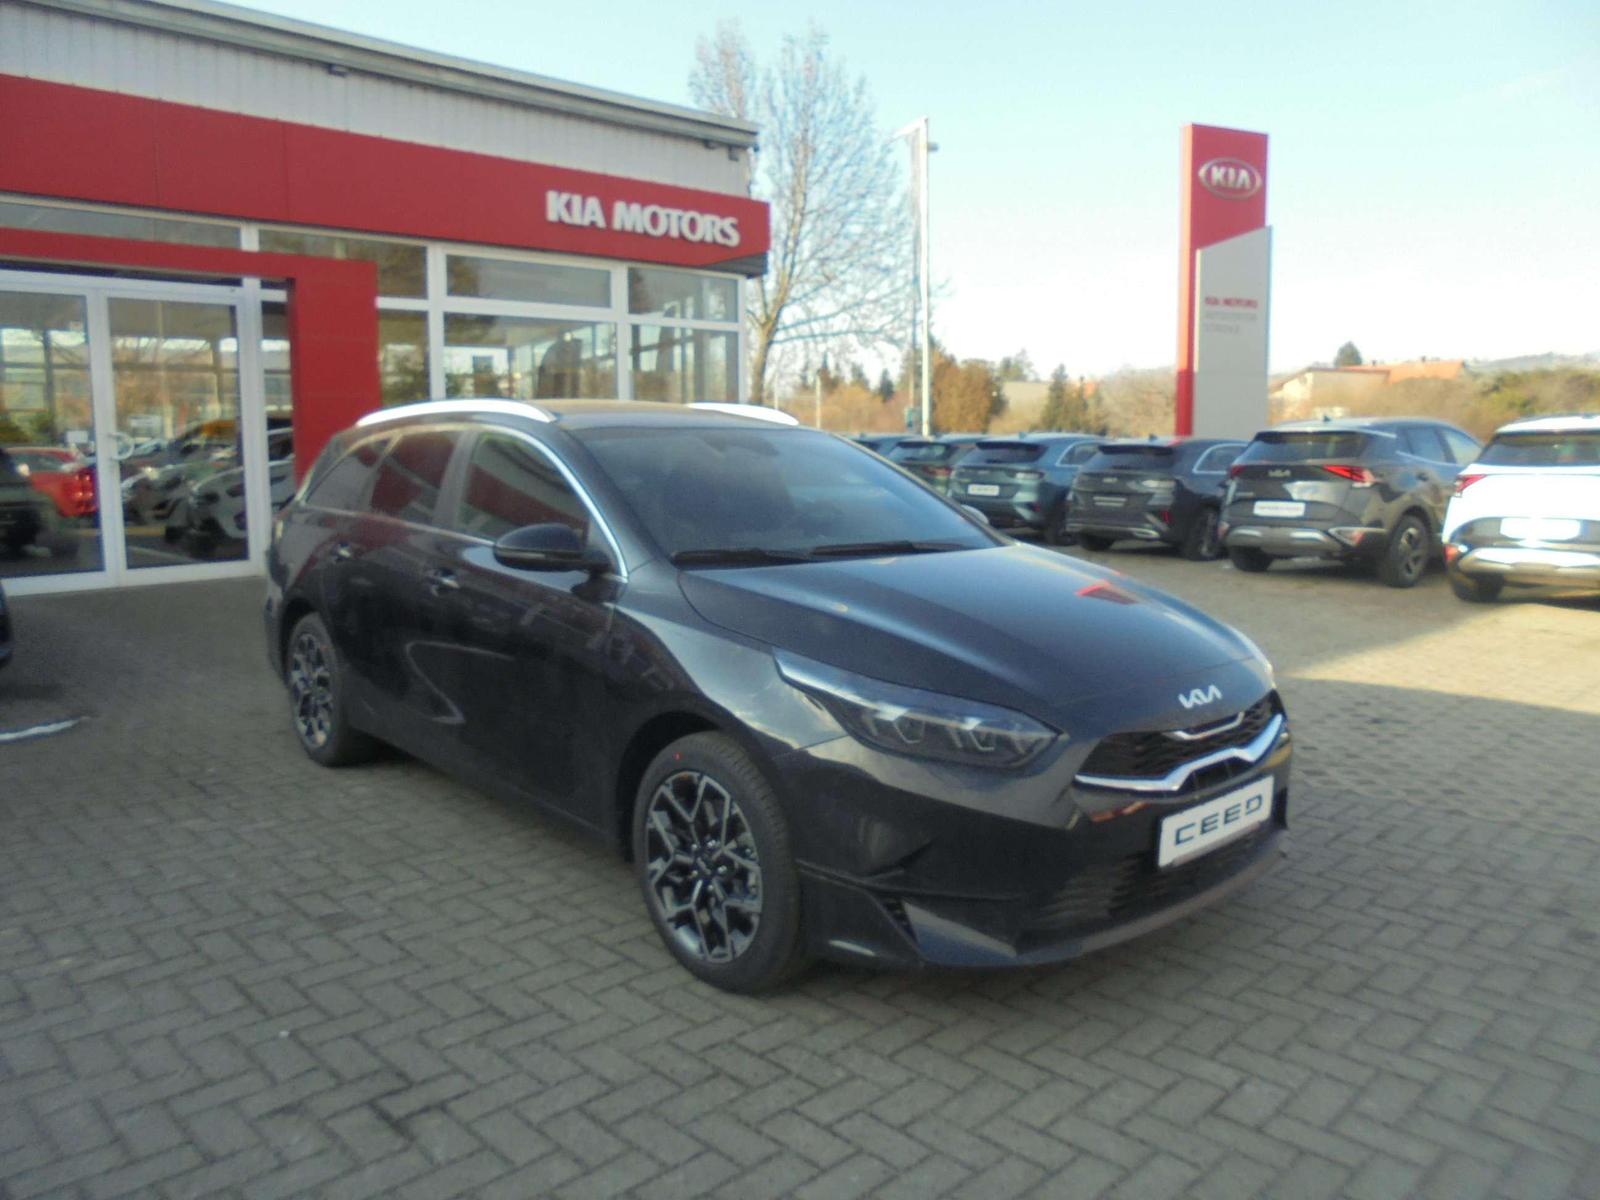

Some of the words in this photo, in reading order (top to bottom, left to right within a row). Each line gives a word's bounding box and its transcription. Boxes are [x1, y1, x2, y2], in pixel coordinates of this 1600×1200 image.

[1210, 165, 1251, 189] KIA
[545, 190, 606, 229] KIA
[612, 201, 741, 247] MOTORS
[1178, 684, 1223, 709] KIA
[1174, 794, 1263, 846] CEED
